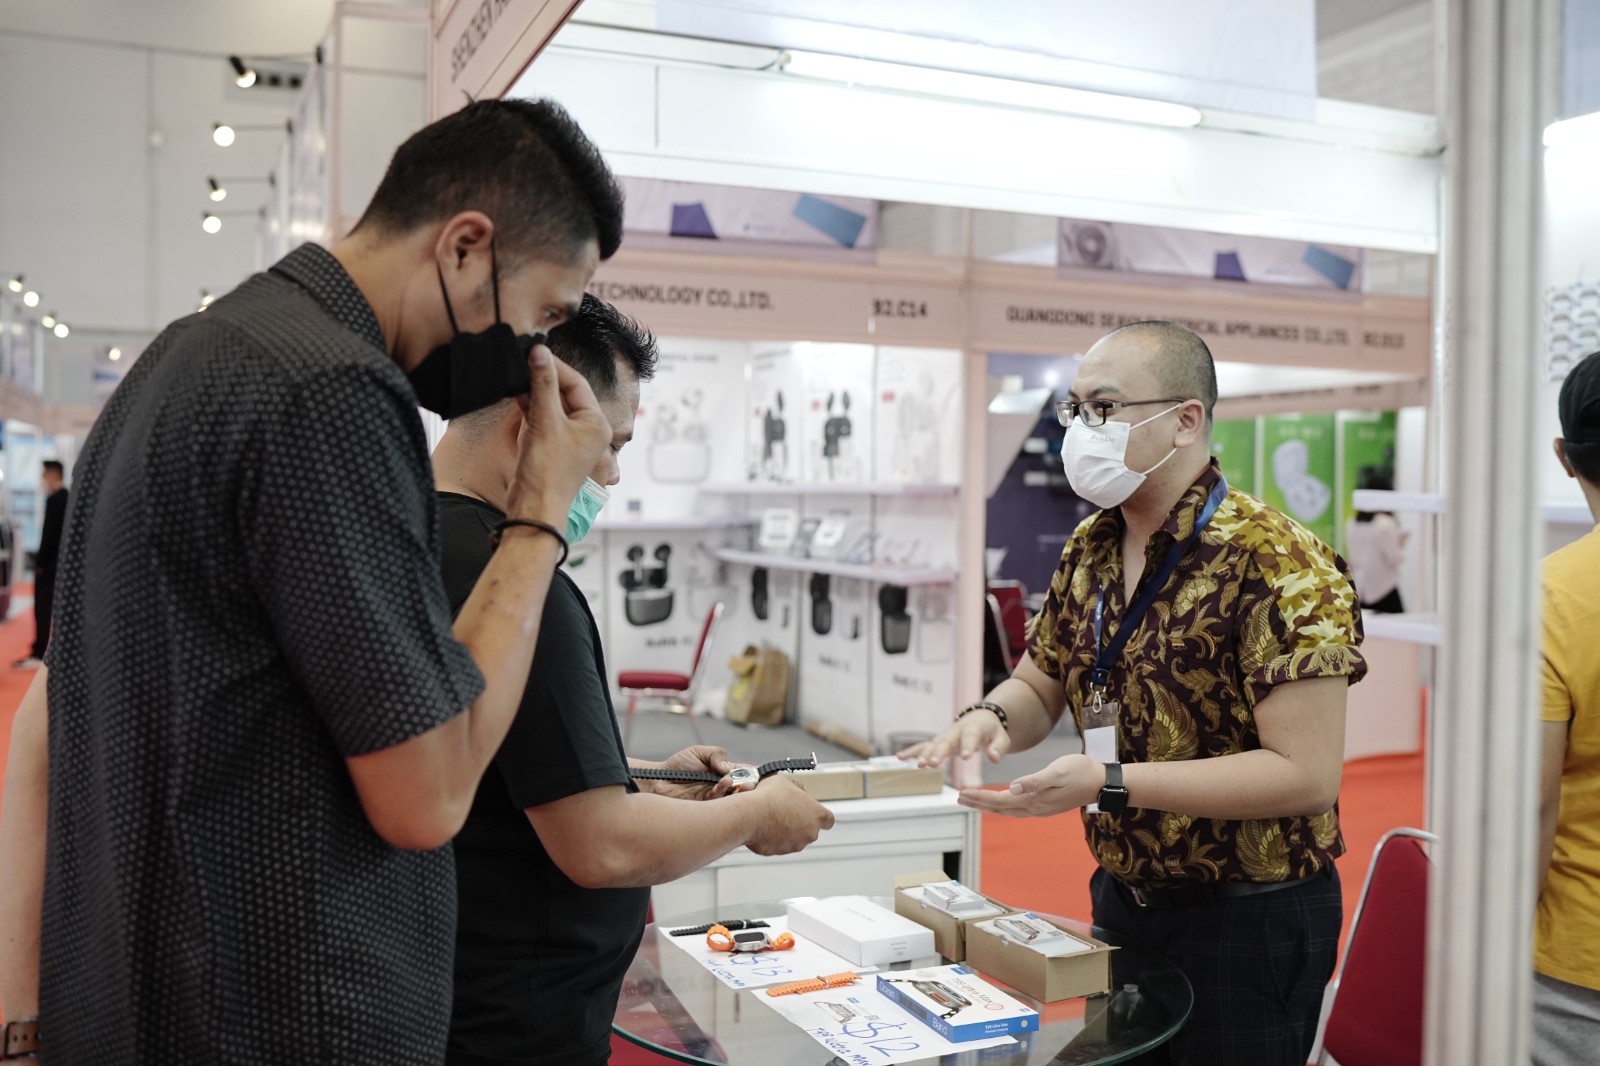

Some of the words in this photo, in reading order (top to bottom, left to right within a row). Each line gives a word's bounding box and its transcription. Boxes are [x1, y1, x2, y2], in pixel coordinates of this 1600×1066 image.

[589, 281, 703, 305] TECHNOLOGY
[1006, 304, 1096, 326] GUANGDONG
[879, 980, 896, 999] Ocean
[932, 1018, 948, 1035] Band
[836, 1020, 921, 1058] $12
